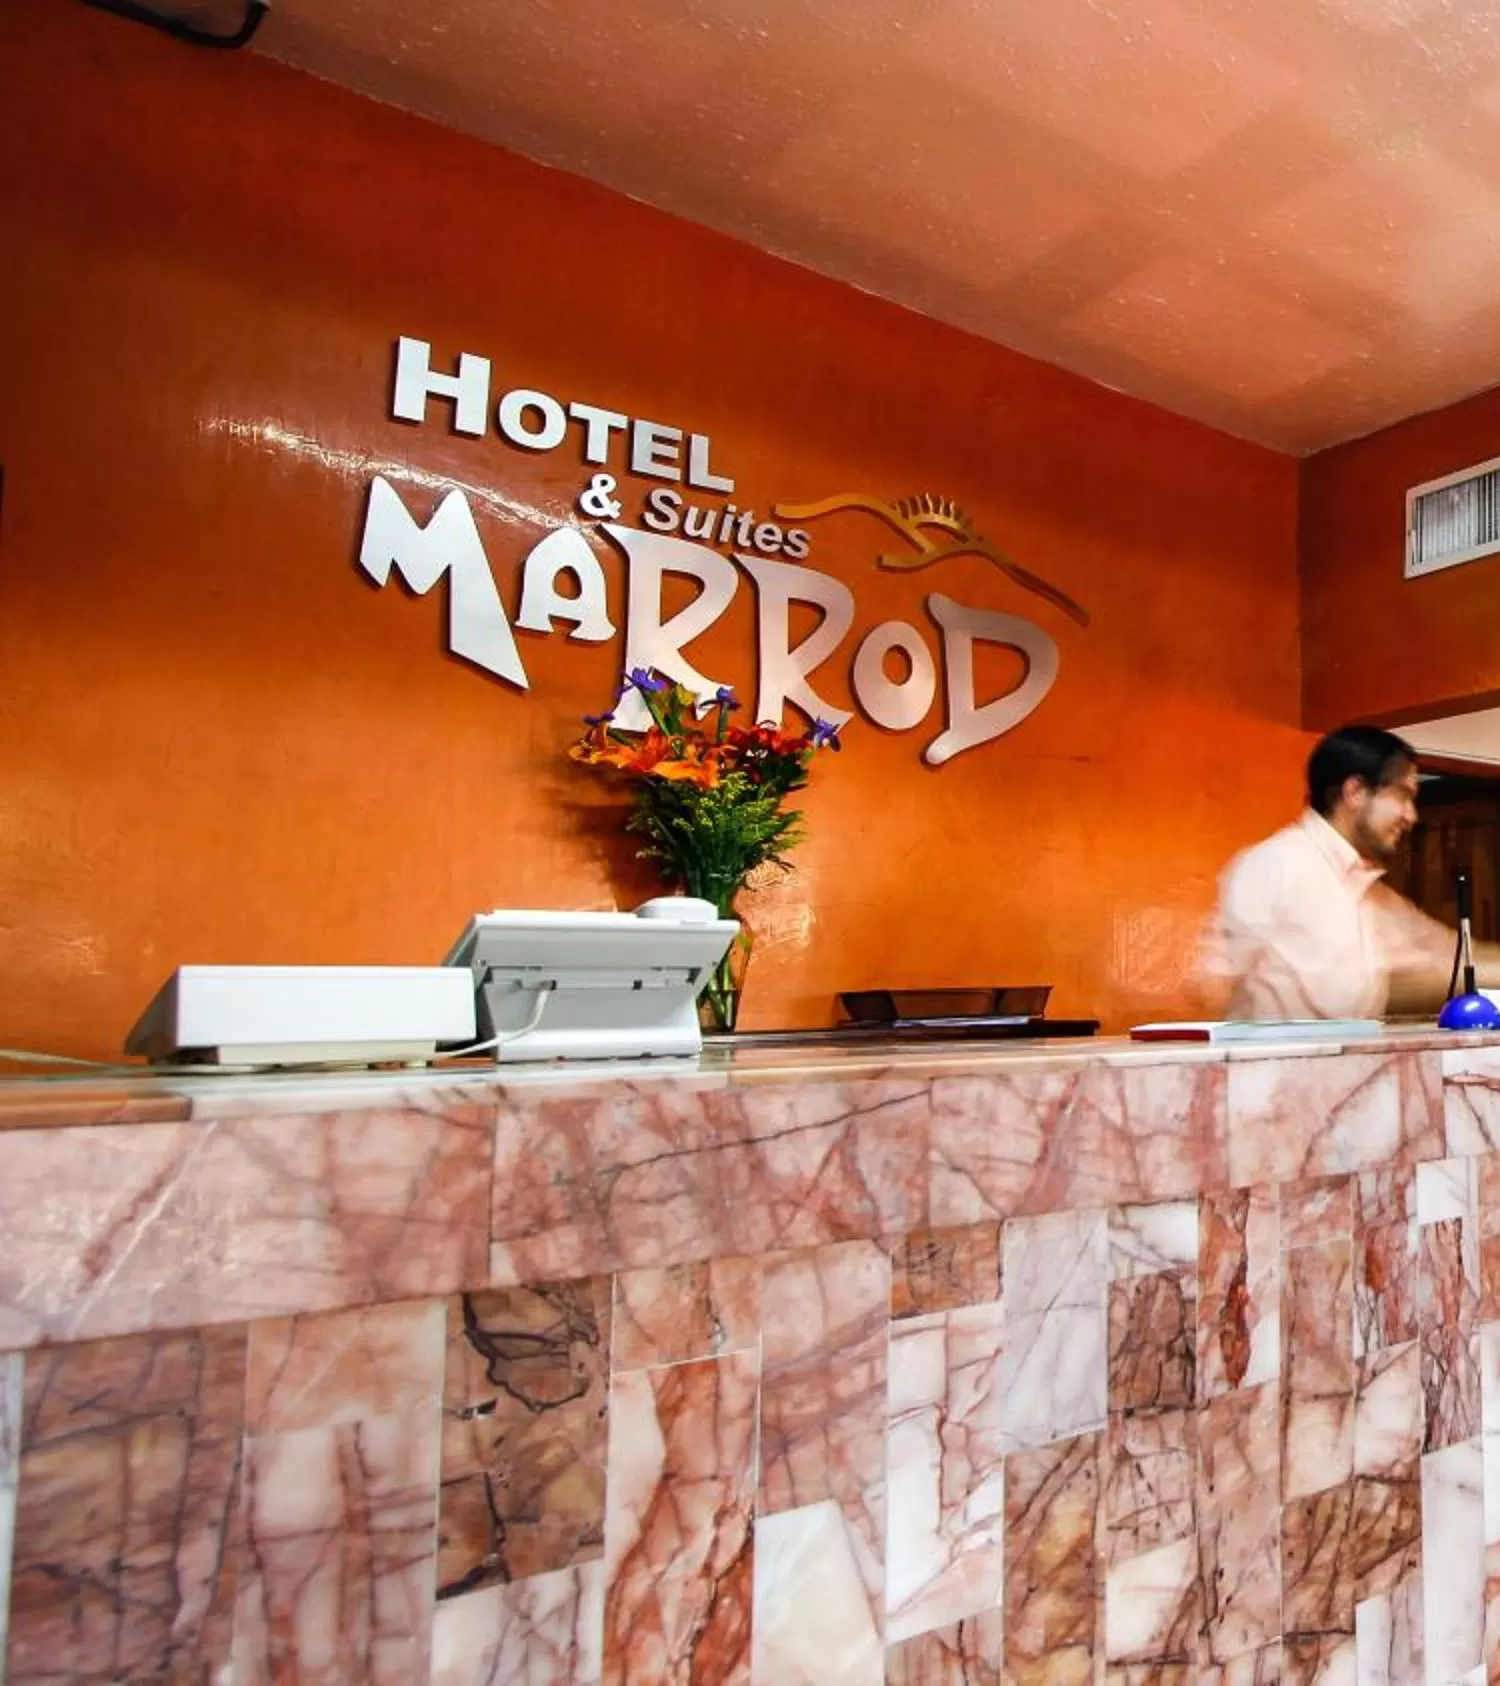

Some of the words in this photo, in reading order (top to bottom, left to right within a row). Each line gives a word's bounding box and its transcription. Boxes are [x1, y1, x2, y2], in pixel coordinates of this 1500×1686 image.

[393, 336, 735, 493] HOTEL
[580, 473, 621, 518] &
[643, 488, 812, 559] Suites
[360, 475, 1060, 765] MARROD
